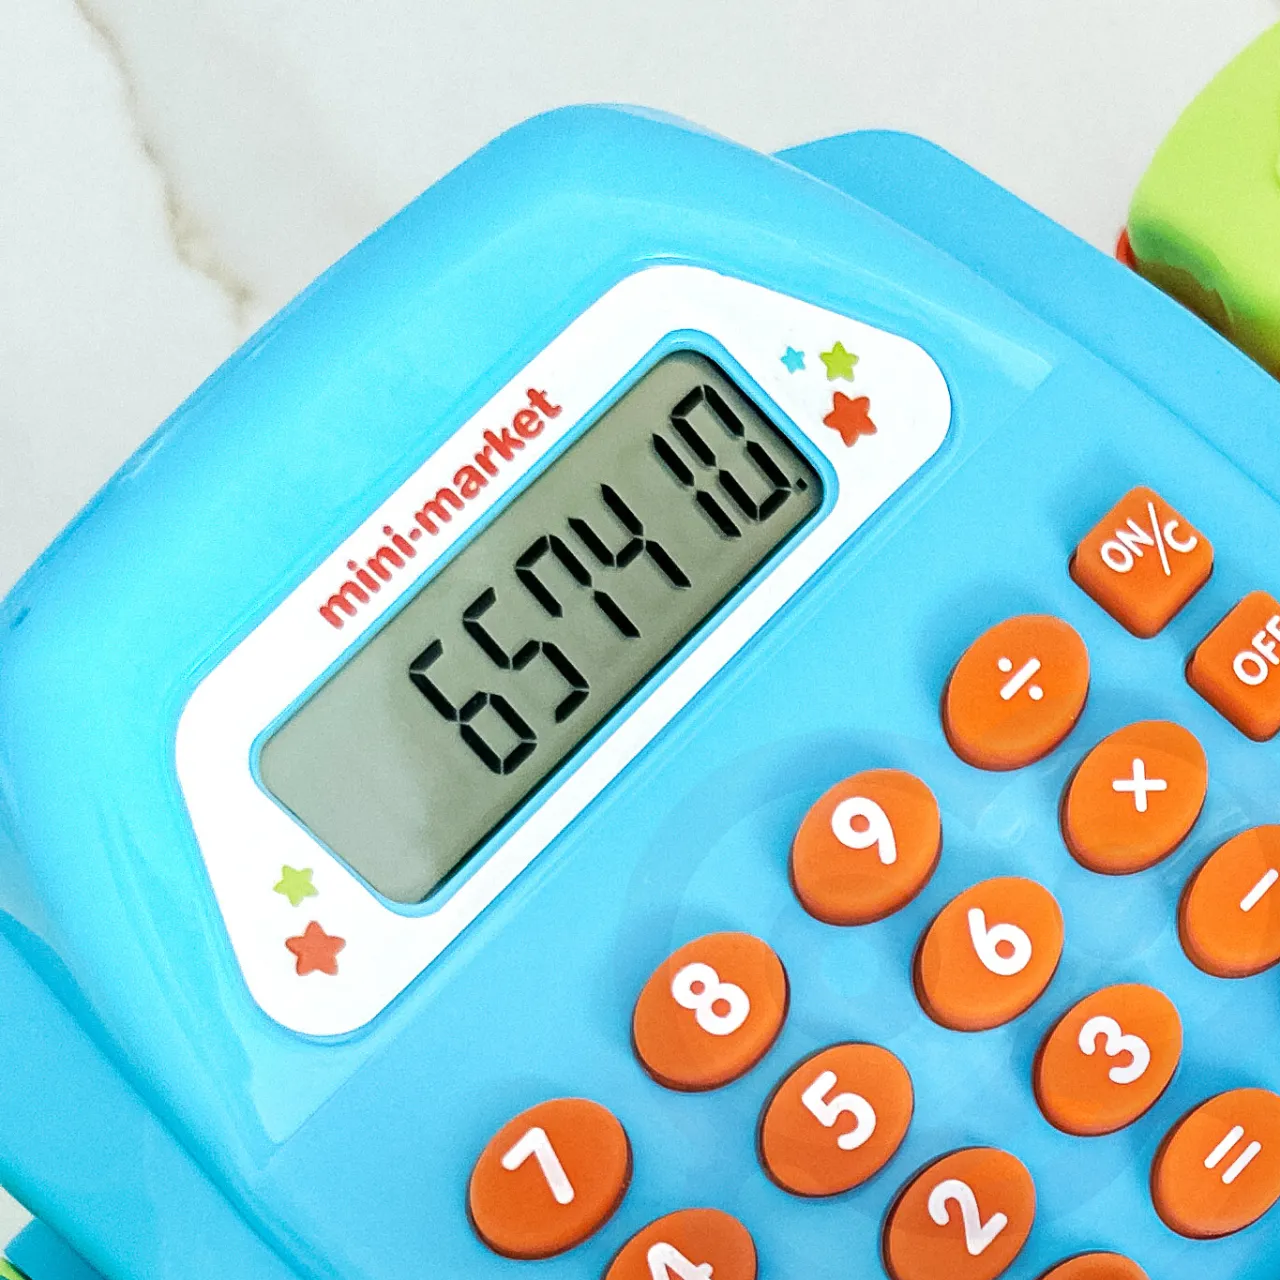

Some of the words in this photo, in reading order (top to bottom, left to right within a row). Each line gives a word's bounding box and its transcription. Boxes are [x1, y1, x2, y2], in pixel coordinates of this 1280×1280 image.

[319, 388, 562, 629] mini-market
[1099, 501, 1199, 576] ON/C
[831, 796, 897, 865] 9
[967, 907, 1032, 976] 6
[670, 962, 750, 1036] 8
[1078, 1015, 1151, 1085] 3
[801, 1070, 877, 1150] 5
[501, 1127, 575, 1205] 7
[927, 1179, 1008, 1256] 2
